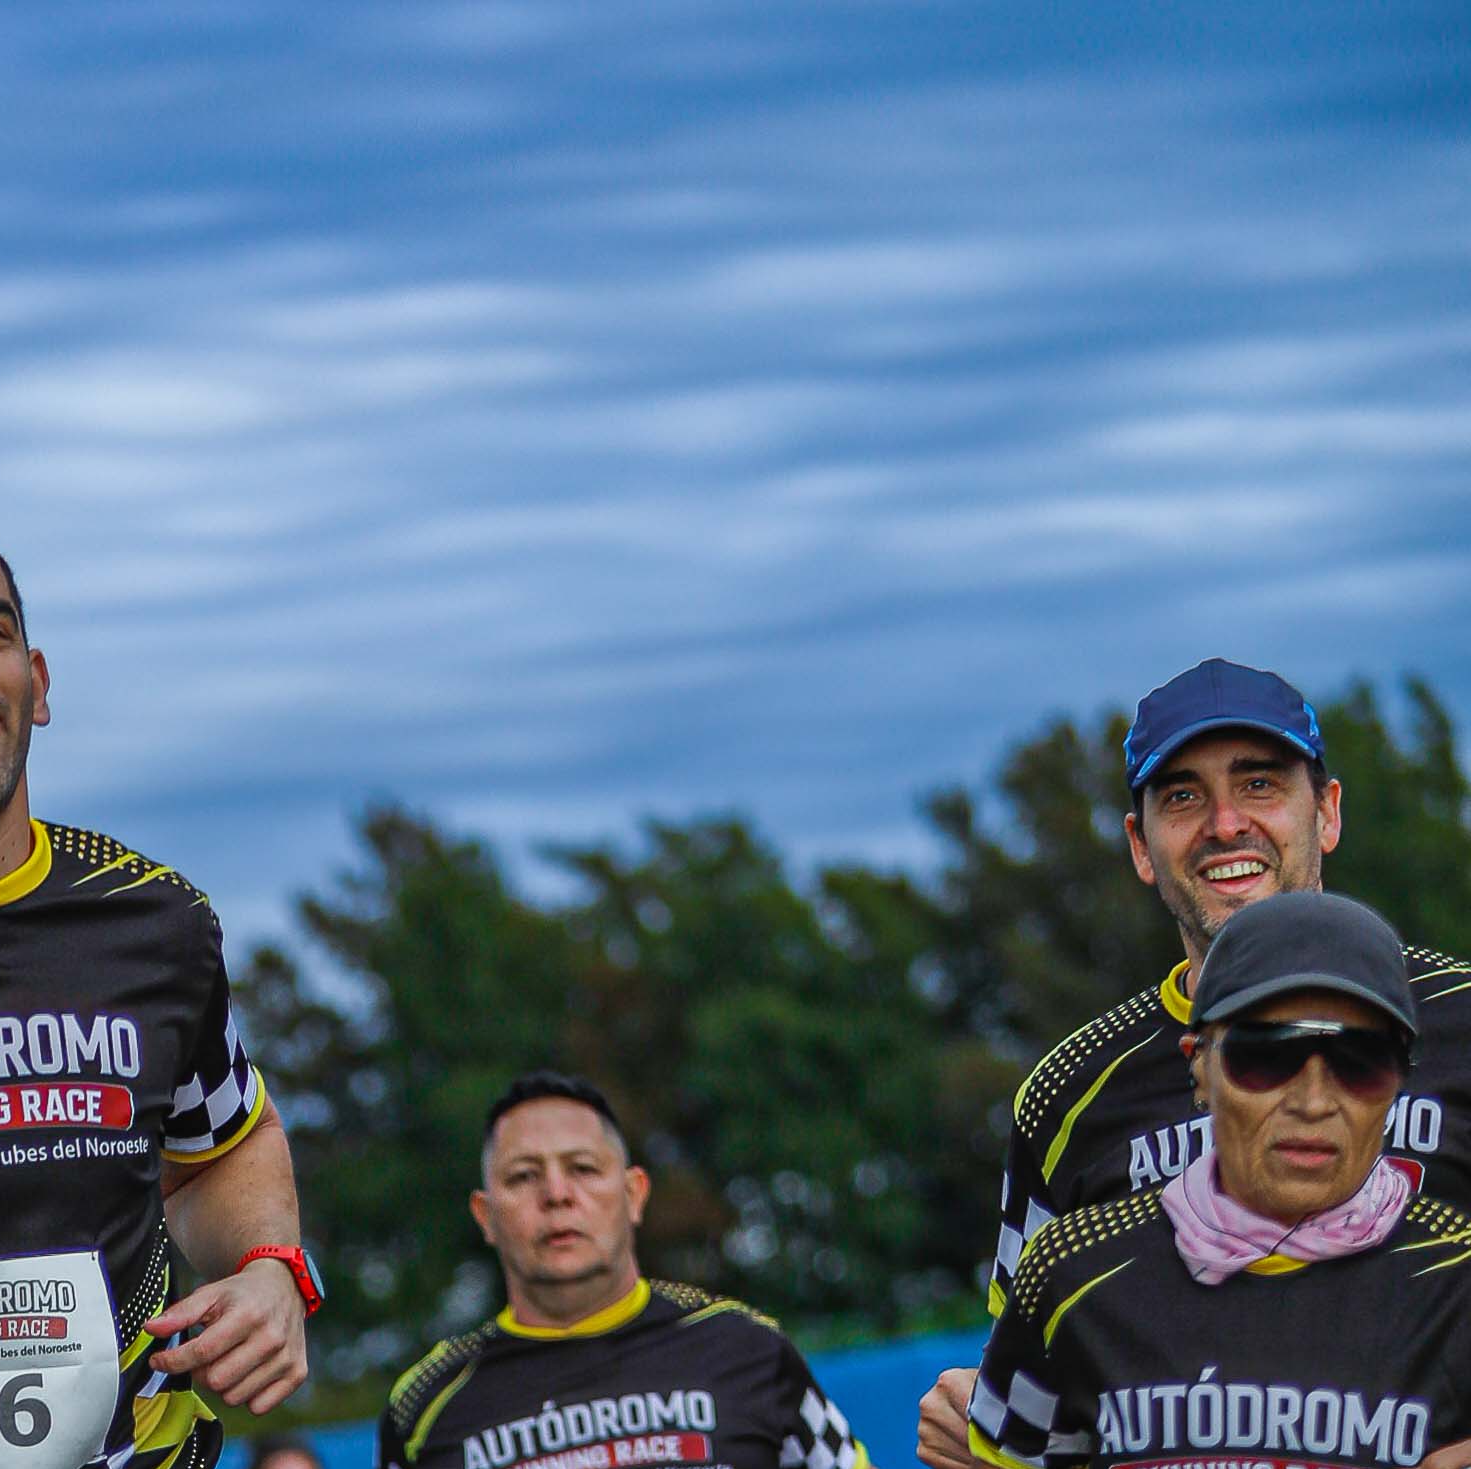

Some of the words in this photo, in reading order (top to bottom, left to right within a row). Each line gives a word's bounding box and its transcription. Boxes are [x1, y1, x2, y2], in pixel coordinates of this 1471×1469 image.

[20, 1088, 103, 1125] RACE
[53, 1139, 80, 1161] del
[86, 1135, 149, 1157] Noroeste
[8, 1319, 49, 1338] RACE
[21, 1345, 36, 1356] del
[38, 1342, 82, 1355] Noroeste
[1097, 1366, 1428, 1467] AUTÓDROMO
[613, 1435, 682, 1466] RACE
